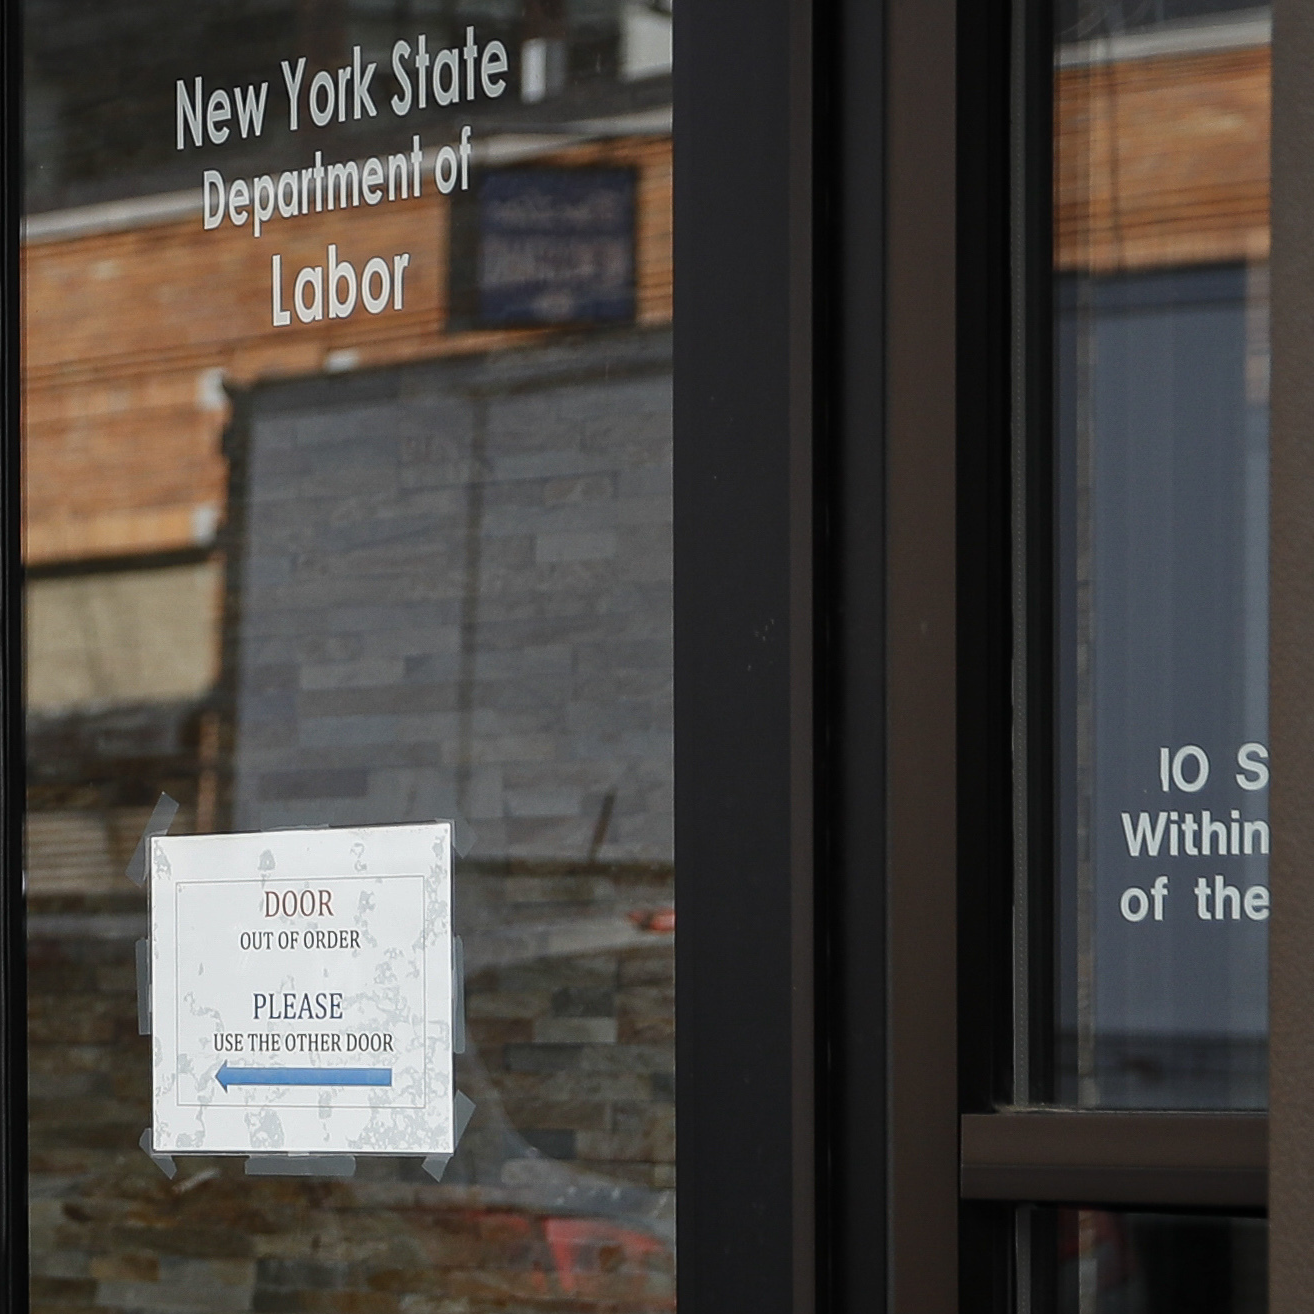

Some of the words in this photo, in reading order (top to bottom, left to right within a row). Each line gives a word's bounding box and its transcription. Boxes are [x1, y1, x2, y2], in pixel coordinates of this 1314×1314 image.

[176, 76, 269, 151] New
[281, 45, 378, 131] York
[391, 26, 508, 116] State
[203, 135, 422, 237] Department
[435, 125, 473, 194] of
[272, 244, 410, 327] Labor
[1121, 810, 1269, 856] Within
[264, 890, 333, 918] DOOR
[1120, 876, 1168, 922] of
[1194, 875, 1270, 920] the
[240, 931, 274, 950] OUT
[278, 931, 298, 949] OF
[304, 930, 361, 949] ORDER
[253, 993, 343, 1020] PLEASE
[214, 1033, 243, 1052] USE
[248, 1033, 280, 1051] THE
[285, 1033, 341, 1051] OTHER
[346, 1033, 394, 1052] DOOR
